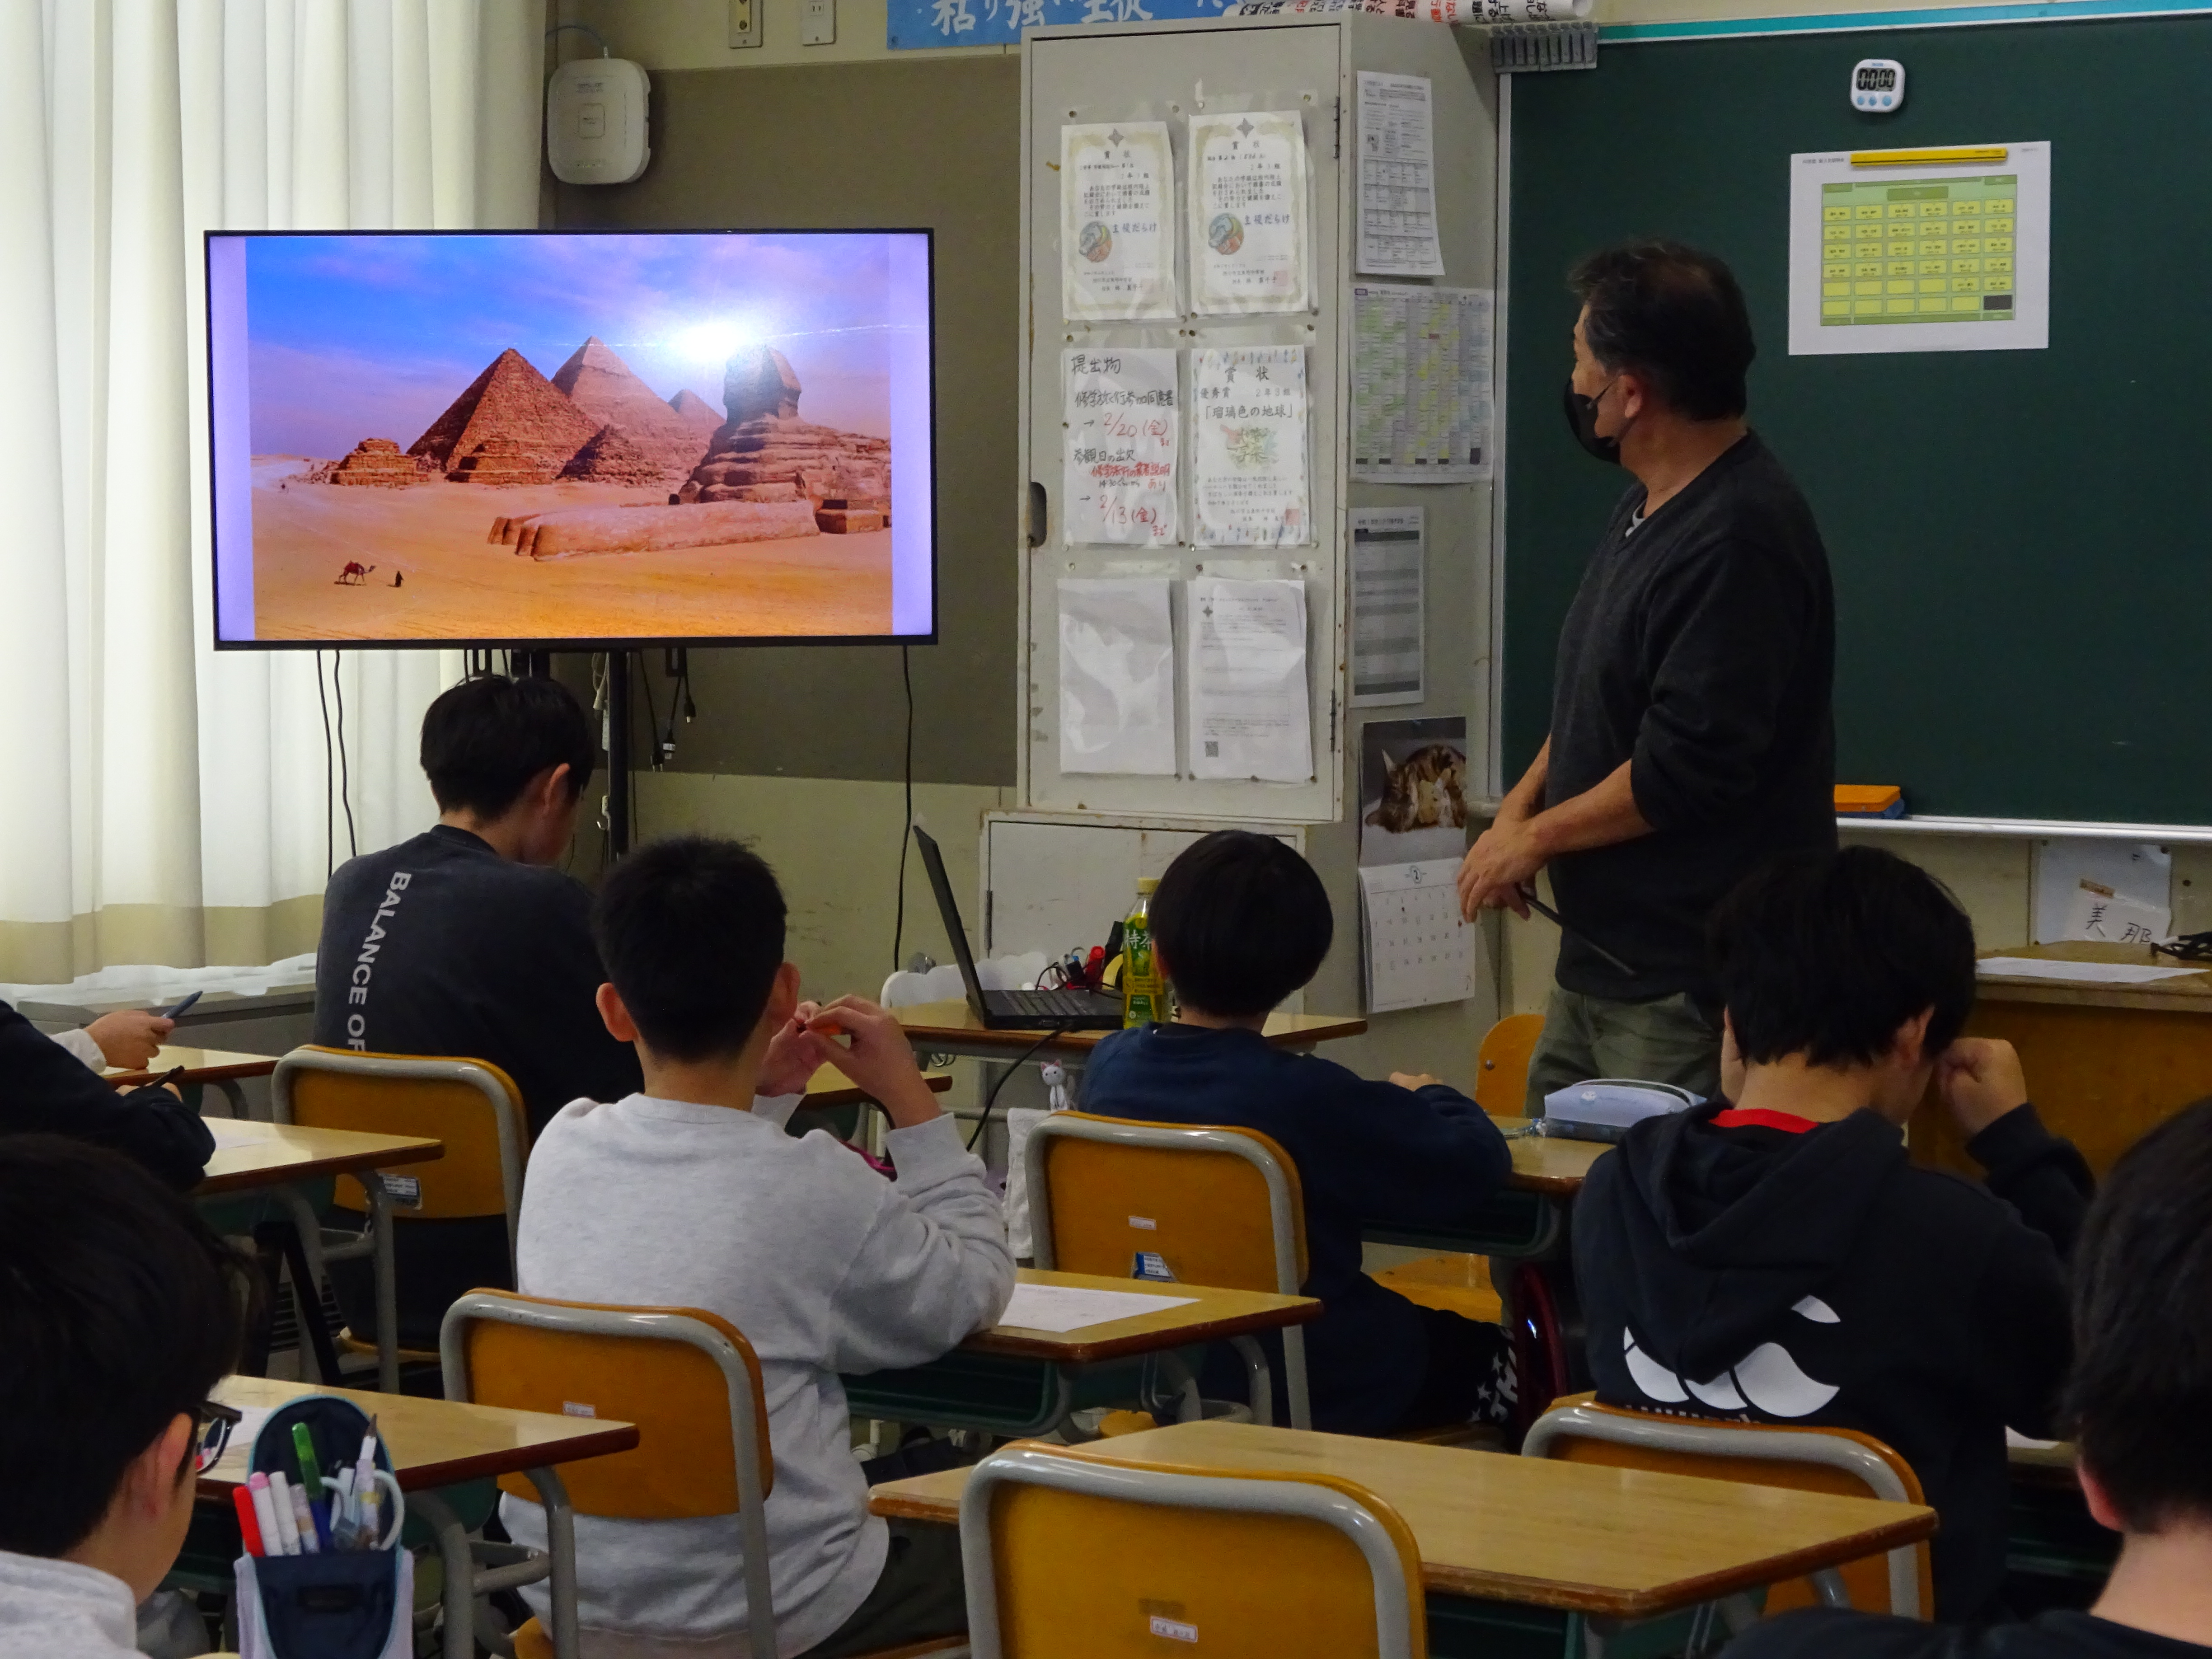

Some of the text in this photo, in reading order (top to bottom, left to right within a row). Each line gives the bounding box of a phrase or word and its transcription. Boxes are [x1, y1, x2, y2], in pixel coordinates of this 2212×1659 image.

[1071, 354, 1121, 375] 提出物
[347, 871, 412, 1051] BALANCE OF
